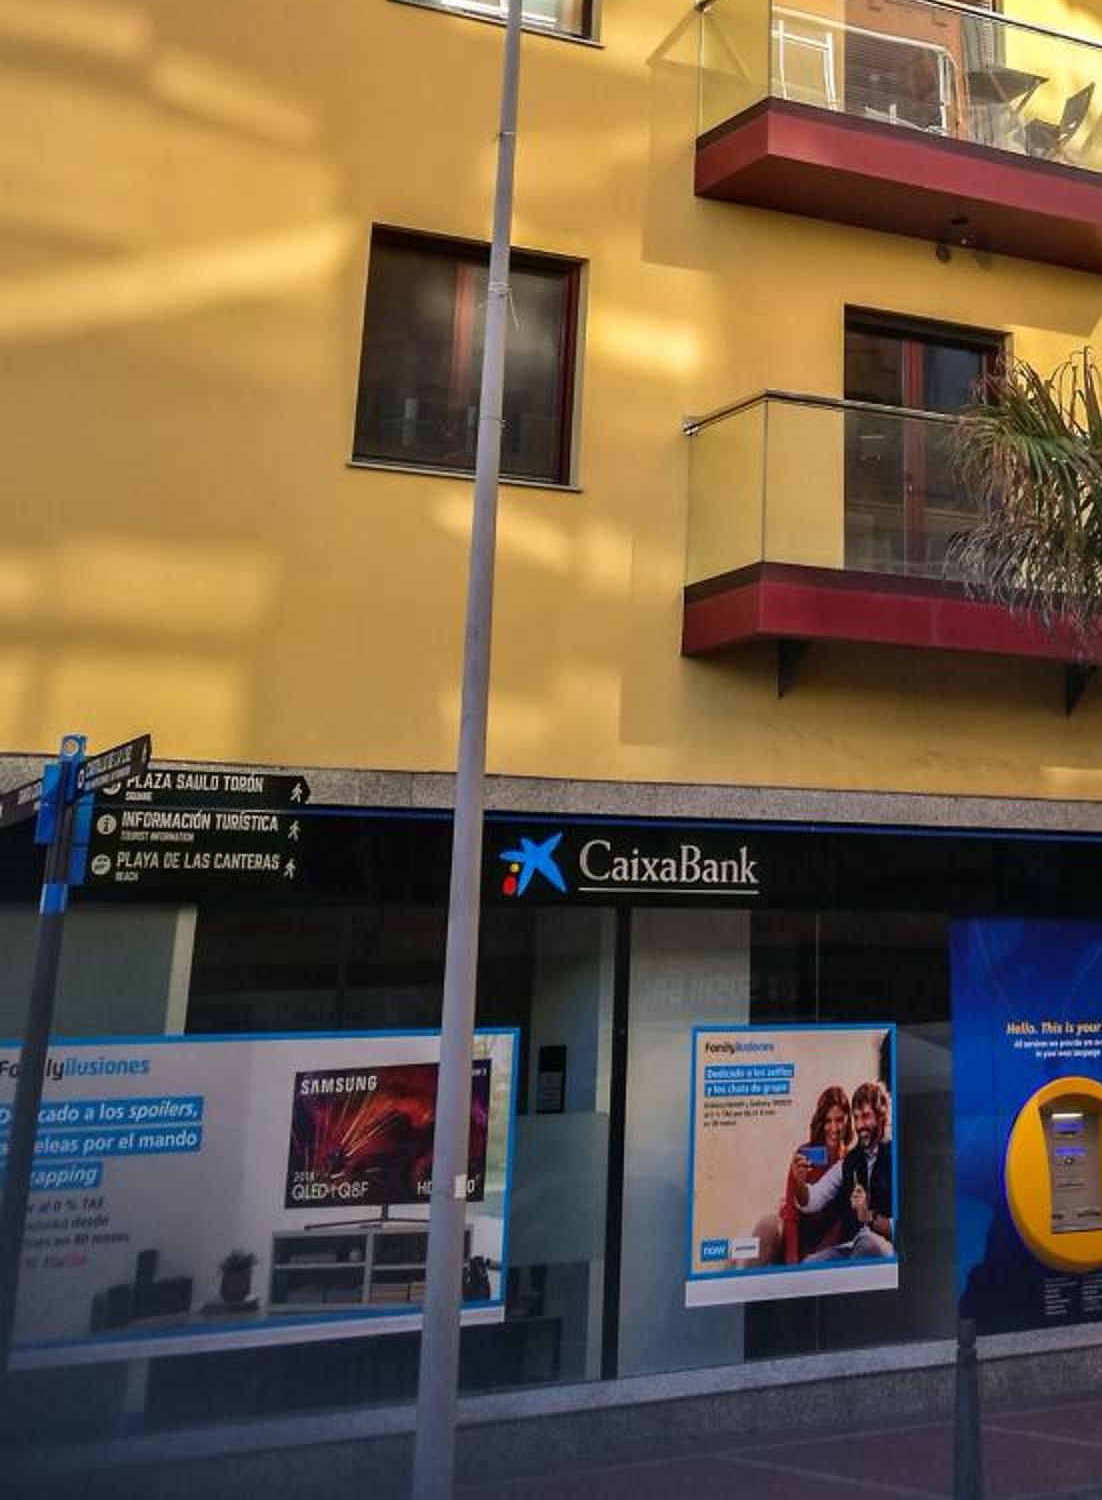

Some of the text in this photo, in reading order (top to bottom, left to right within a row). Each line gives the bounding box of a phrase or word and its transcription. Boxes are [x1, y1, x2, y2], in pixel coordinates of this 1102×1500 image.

[126, 773, 171, 789] PLAZA
[176, 773, 219, 792] SAULO
[223, 773, 265, 792] TORÓN
[121, 809, 279, 832] INFORMACIÓN TURÍSTICA
[116, 851, 281, 871] PLAYA DE LAS CANTERAS
[579, 839, 759, 884] CaixaBank
[1042, 1021, 1062, 1034] This
[1065, 1021, 1074, 1033] is
[1076, 1023, 1101, 1036] your
[0, 1055, 151, 1081] Falyilusiones
[300, 1075, 378, 1095] SAMSUNG
[84, 1108, 95, 1121] a
[99, 1103, 124, 1121] los
[128, 1100, 198, 1122] spoilers,
[33, 1129, 198, 1155] eleas por el mando
